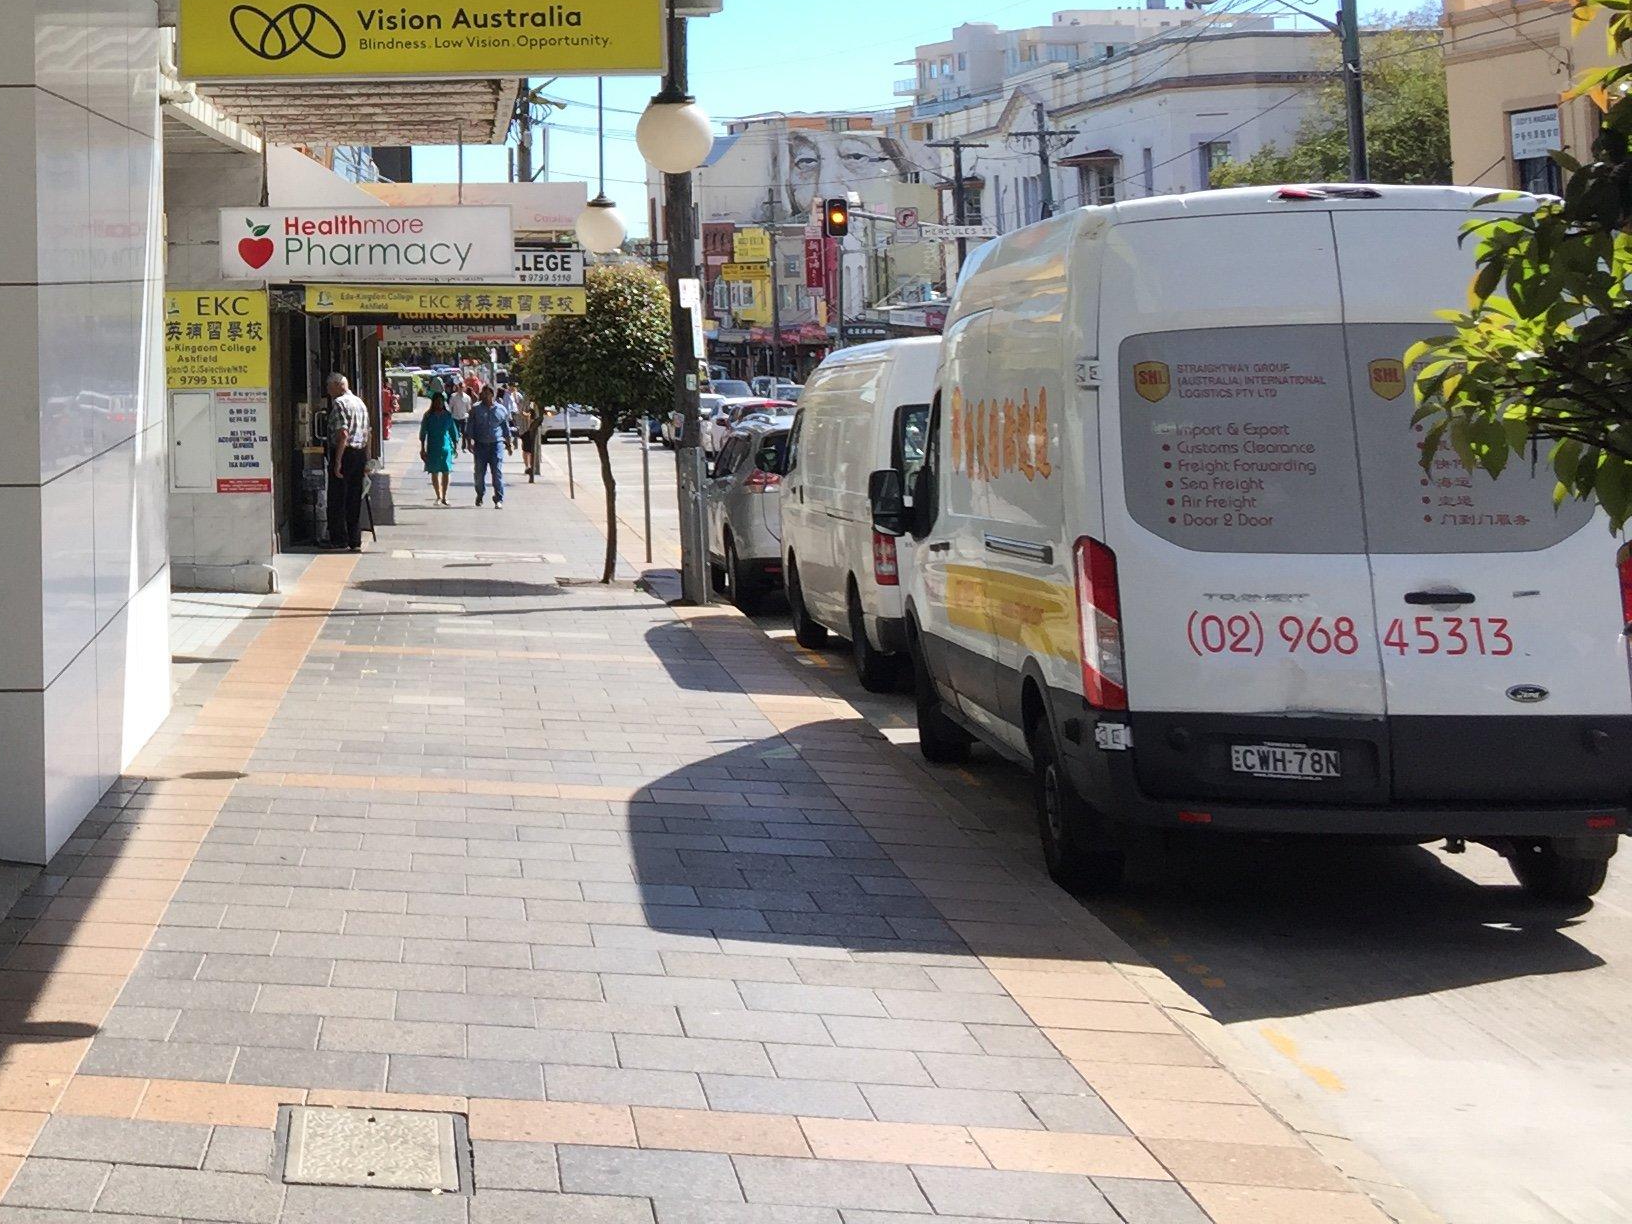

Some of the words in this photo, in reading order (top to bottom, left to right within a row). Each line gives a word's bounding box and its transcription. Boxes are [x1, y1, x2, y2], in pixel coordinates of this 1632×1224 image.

[356, 7, 442, 31] Vision
[452, 4, 582, 29] Australia
[434, 36, 464, 49] Low
[284, 215, 424, 237] Healthmore
[284, 237, 473, 271] Pharmacy
[515, 254, 572, 272] LEGE
[197, 296, 250, 316] EKC
[419, 295, 451, 309] EKC
[411, 325, 449, 334] GREEN
[451, 324, 496, 333] HEALTH
[220, 343, 257, 354] College
[176, 354, 218, 363] Ashfield
[1177, 363, 1250, 374] STRAIGHTWAY
[1254, 362, 1291, 373] GROUP
[1373, 367, 1401, 383] SHL
[180, 375, 208, 386] 9799
[209, 375, 239, 386] 5110
[1138, 369, 1167, 385] SHL
[1245, 375, 1328, 386] INTERNATIONAL
[1179, 388, 1234, 399] LOGISTICS
[1235, 387, 1256, 397] PTY
[1257, 387, 1277, 397] LTD
[1227, 422, 1239, 436] &
[1243, 423, 1290, 438] Export
[1177, 440, 1239, 455] Customs
[1243, 440, 1316, 454] Clearance
[1177, 459, 1230, 475] Freight
[1233, 458, 1316, 475] Forwarding
[1180, 477, 1209, 491] Sea
[1181, 495, 1201, 508] Air
[1183, 513, 1217, 526] Door
[1223, 513, 1233, 526] 2
[1238, 513, 1274, 526] Door
[1187, 610, 1264, 657] (02)
[1279, 615, 1360, 656] 968
[1383, 616, 1515, 657] 45313
